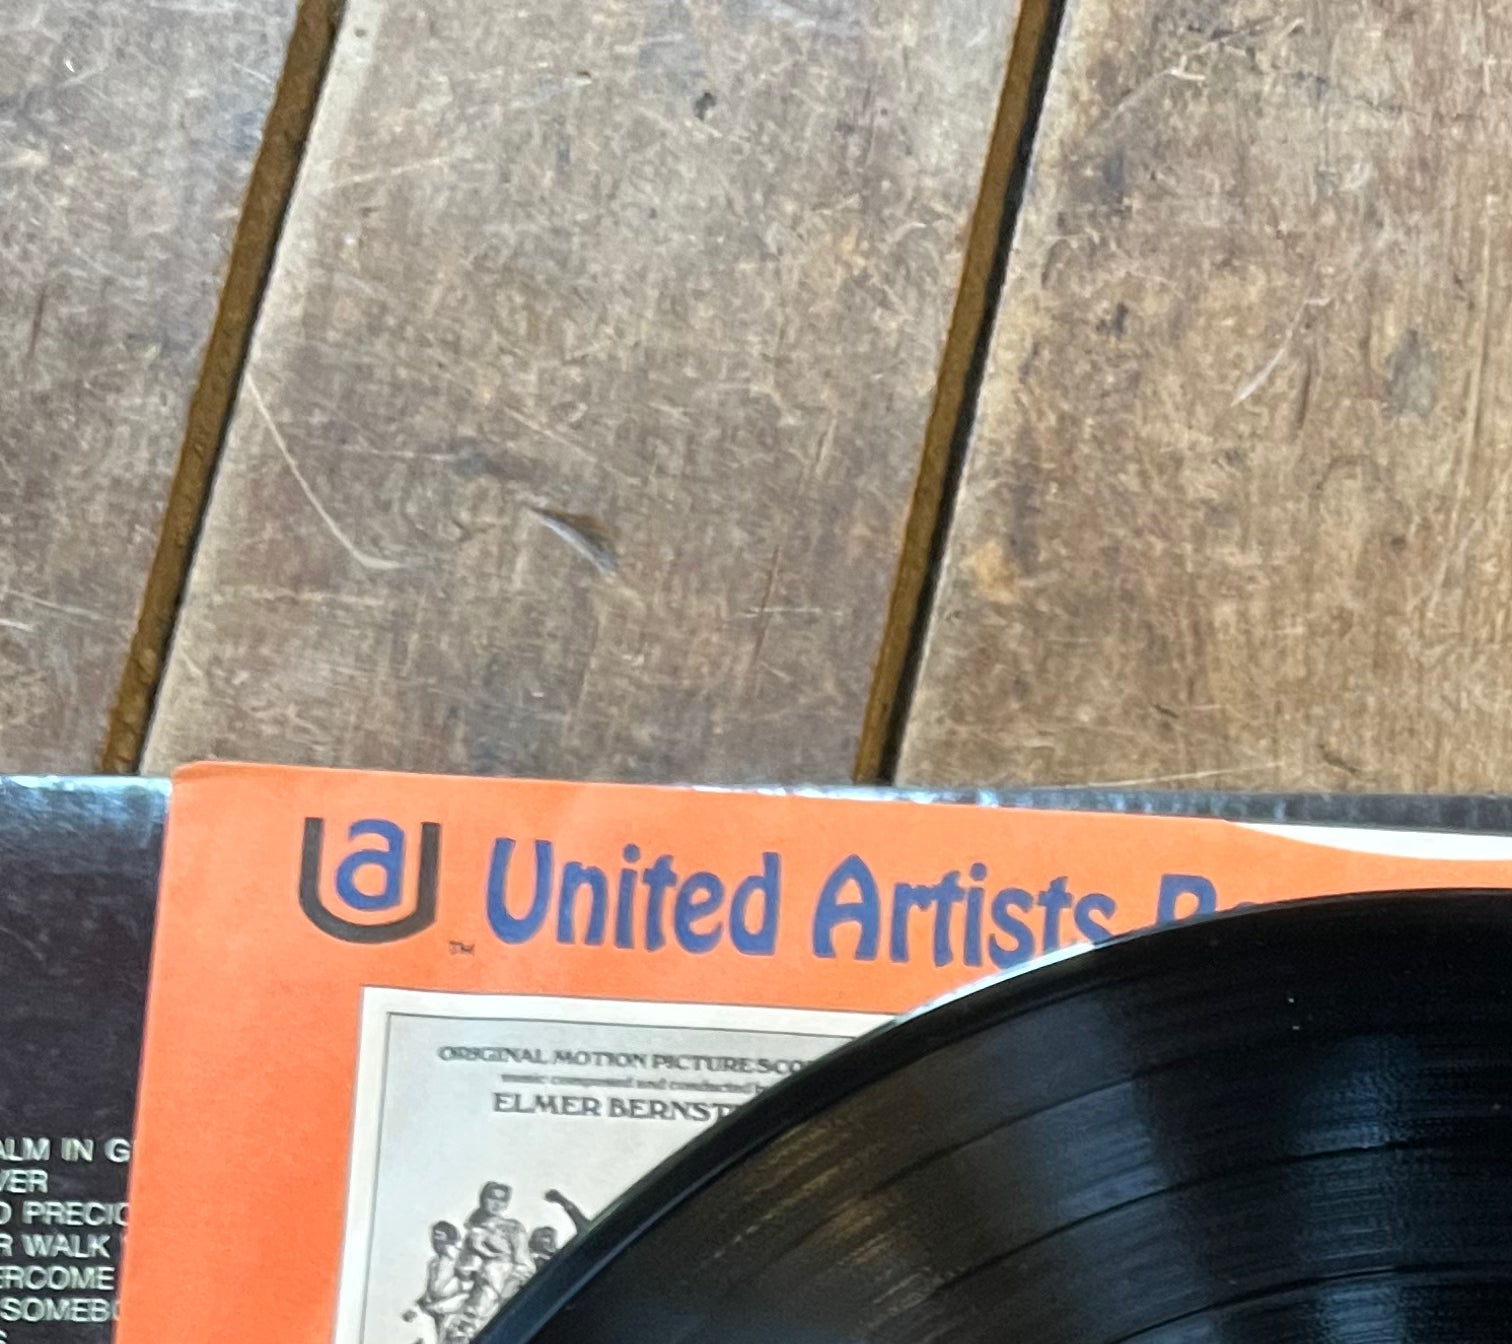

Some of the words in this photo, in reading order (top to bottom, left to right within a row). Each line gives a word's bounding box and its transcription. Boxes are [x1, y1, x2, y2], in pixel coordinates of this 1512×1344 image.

[484, 836, 782, 956] United
[812, 853, 1116, 969] Artists
[438, 1046, 547, 1064] ORIGINAL
[553, 1049, 647, 1069] MOTION
[652, 1053, 757, 1073] PICTURE
[493, 1092, 602, 1117] ELMER
[61, 1137, 94, 1162] IN
[21, 1233, 111, 1258] WALK
